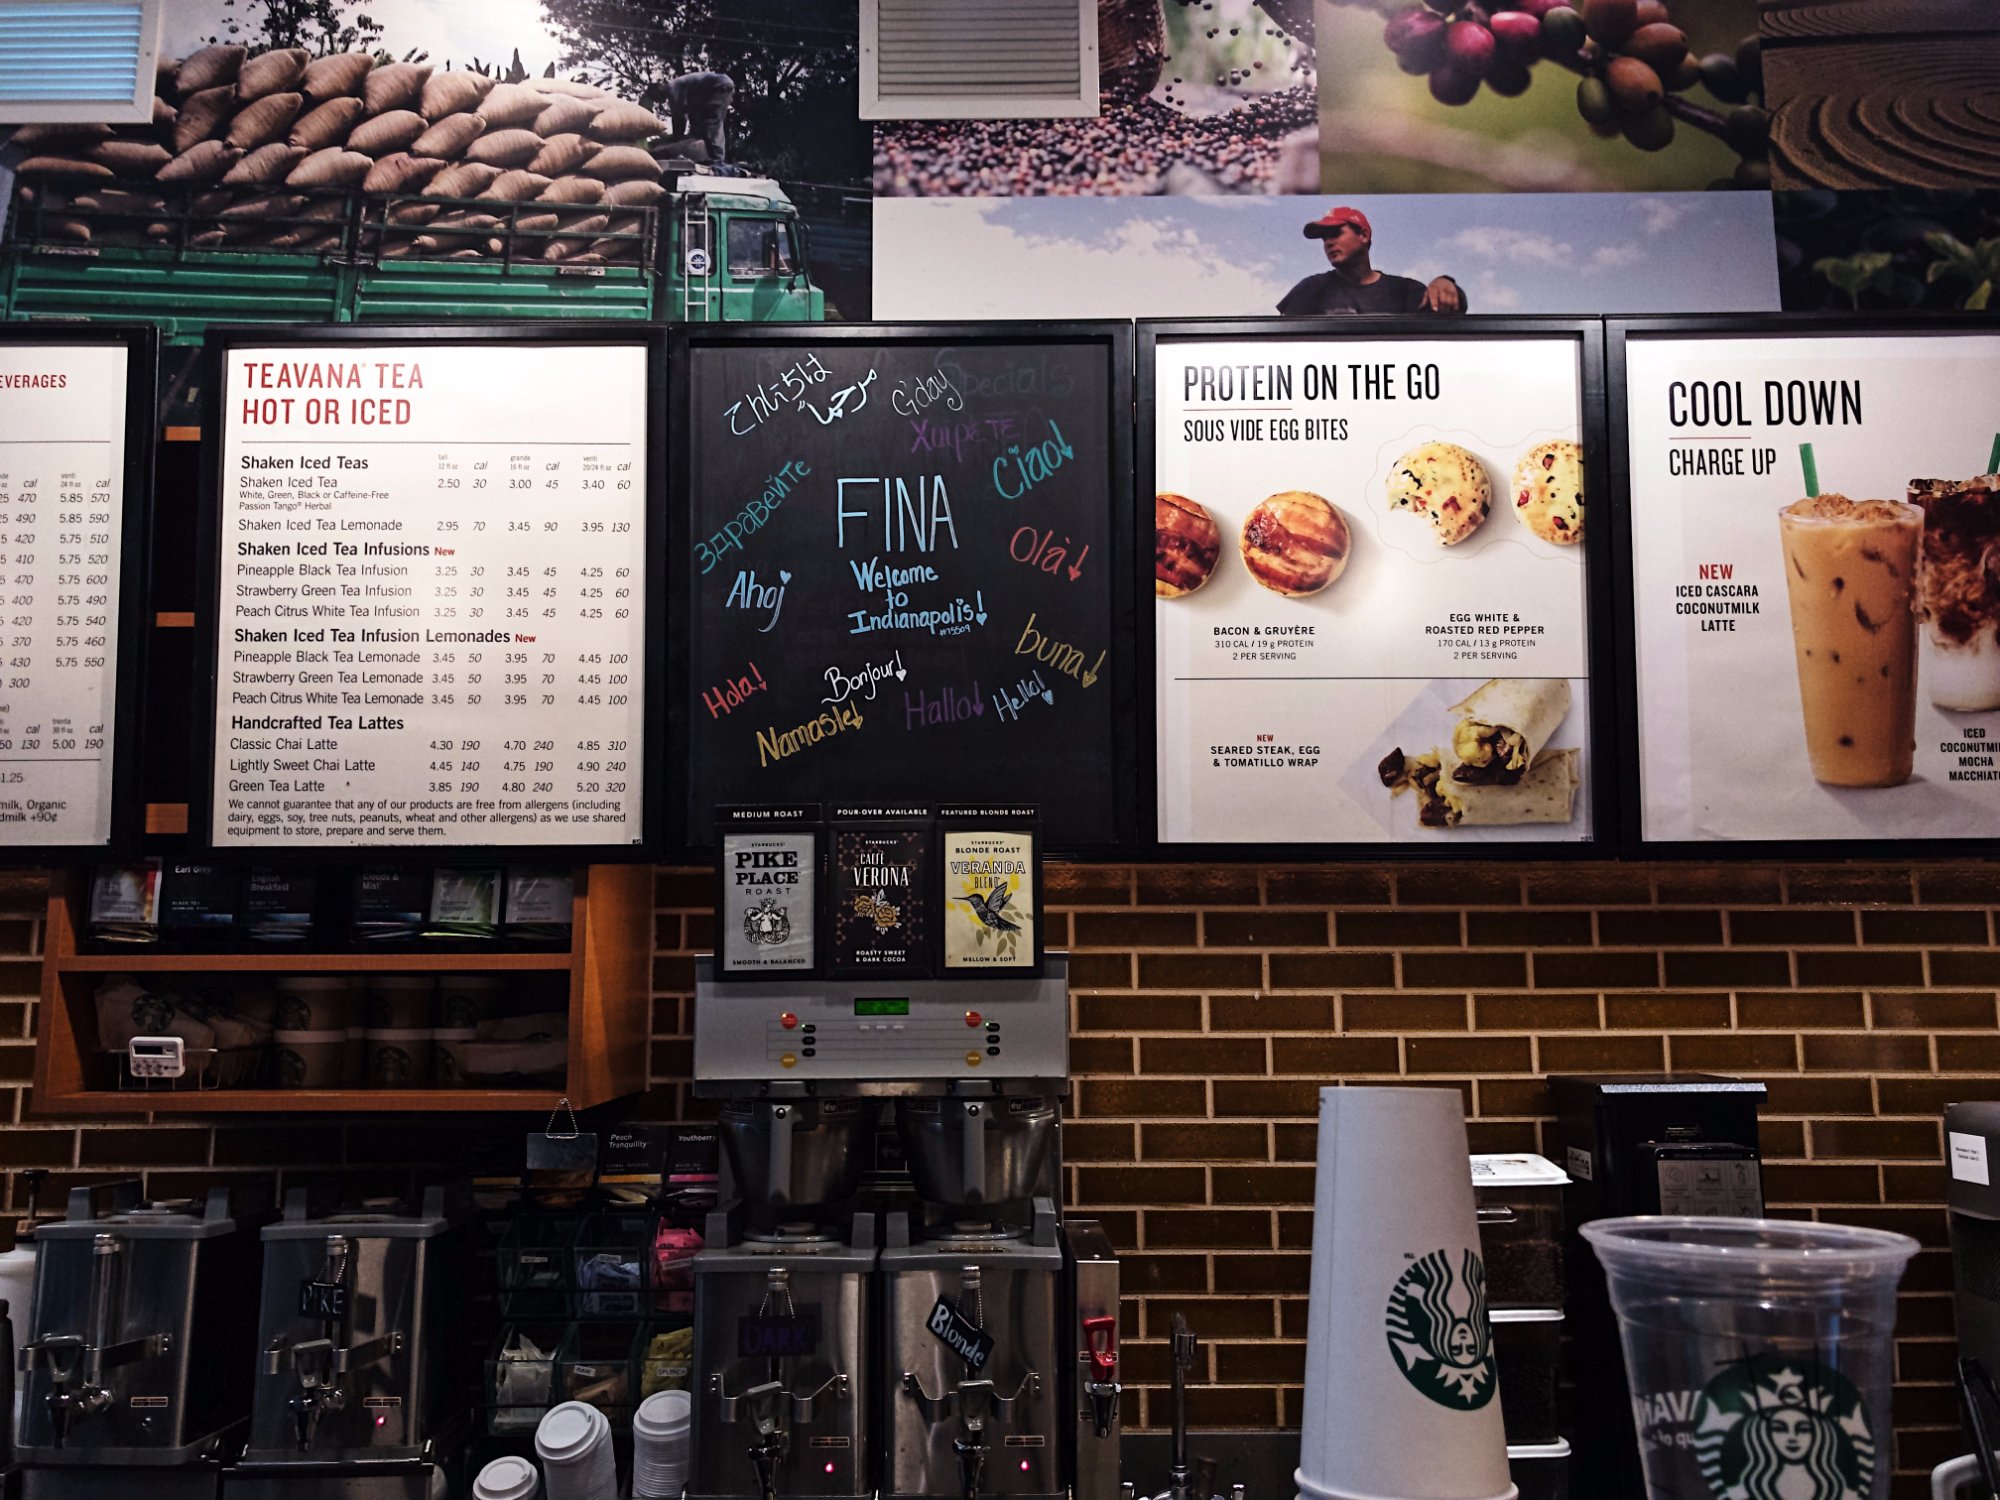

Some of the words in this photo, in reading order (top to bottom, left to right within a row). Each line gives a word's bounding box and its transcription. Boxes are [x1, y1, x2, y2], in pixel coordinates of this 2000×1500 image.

[375, 363, 423, 389] TEA
[1184, 364, 1292, 402] PROTEIN
[1303, 363, 1337, 401] ON
[1347, 363, 1397, 400] THE
[1406, 363, 1440, 401] GO
[1669, 380, 1752, 427] COOL
[1764, 380, 1862, 426] DOWN
[242, 398, 296, 425] HOT
[305, 398, 340, 425] OR
[351, 398, 411, 426] ICED
[1183, 419, 1225, 442] SOUS
[1230, 419, 1264, 442] VIDE
[1270, 418, 1299, 441] EGG
[1305, 418, 1348, 441] BITES
[241, 455, 294, 470] Shaken
[300, 455, 331, 469] Iced
[336, 455, 369, 470] Teas
[993, 420, 1073, 499] Ciao!
[1669, 448, 1745, 476] CHARGE
[1751, 448, 1777, 476] UP
[837, 475, 959, 552] FINA
[237, 541, 291, 556] Shaken
[296, 541, 328, 556] Iced
[332, 541, 358, 556] Tea
[364, 541, 430, 556] Infusions
[434, 546, 455, 556] New
[850, 557, 939, 592] Welcome
[1699, 564, 1733, 580] NEW
[1676, 585, 1703, 598] ICED
[1705, 584, 1759, 598] CASCARA
[725, 570, 792, 632] Ahoj
[885, 590, 909, 609] to
[235, 604, 271, 617] Peach
[274, 604, 309, 617] Citrus
[311, 605, 346, 617] White
[349, 604, 370, 617] Tea
[374, 604, 420, 617] Infusion
[848, 591, 988, 635] Indianapolis!
[1675, 602, 1760, 615] COCONUTMILK
[1449, 613, 1471, 623] EGG
[1474, 613, 1509, 623] WHITE
[1512, 613, 1520, 623] &
[1213, 626, 1250, 636] BACON
[1253, 626, 1261, 636] &
[1264, 624, 1315, 636] GRUYÈRE
[1425, 625, 1474, 635] ROASTED
[1477, 625, 1500, 635] RED
[1503, 625, 1545, 635] PEPPER
[1701, 619, 1736, 632] LATTE
[1214, 640, 1232, 649] 310
[1232, 640, 1249, 648] CAL
[1251, 640, 1255, 648] /
[1257, 640, 1268, 648] 19
[1269, 641, 1276, 650] g
[1277, 639, 1314, 648] PROTEIN
[1438, 639, 1454, 648] 170
[1455, 639, 1472, 648] CAL
[1473, 639, 1477, 647] /
[1479, 639, 1490, 648] 13
[1491, 641, 1498, 649] g
[1499, 639, 1536, 648] PROTEIN
[1232, 652, 1238, 661] 2
[1240, 652, 1257, 661] PER
[1259, 652, 1297, 661] SERVING
[1453, 651, 1459, 660] 2
[1461, 651, 1478, 660] PER
[1480, 651, 1518, 660] SERVING
[821, 650, 907, 704] Bonjour!
[702, 662, 768, 720] Hola!
[992, 670, 1054, 723] Hello!
[904, 681, 985, 730] Hallo!
[231, 715, 322, 730] Handcrafted
[327, 715, 353, 730] Tea
[358, 715, 405, 730] Lattes
[1256, 734, 1274, 743] NEW
[1963, 727, 1986, 739] ICED
[230, 737, 272, 750] Classic
[275, 737, 302, 750] Chai
[307, 738, 338, 750] Latte
[429, 740, 454, 751] 4.30
[461, 740, 481, 751] 190
[503, 740, 527, 751] 4.70
[533, 740, 554, 751] 240
[576, 740, 601, 751] 4.85
[607, 740, 627, 751] 310
[1210, 745, 1253, 755] SEARED
[1256, 745, 1295, 756] STEAK,
[1298, 745, 1321, 755] EGG
[1212, 758, 1221, 767] &
[1224, 758, 1284, 768] TOMATILLO
[1287, 758, 1319, 767] WRAP
[1958, 756, 1994, 767] MOCHA
[1948, 770, 2000, 782] MACCHIAT
[732, 811, 771, 819] MEDIUM
[774, 810, 803, 818] ROAST
[837, 808, 883, 816] POUR-OVER
[955, 846, 989, 854] BLONDE
[993, 846, 1021, 854] ROAST
[735, 850, 798, 869] PIKE
[174, 865, 191, 874] Earl
[949, 860, 1027, 875] VERANDA
[735, 871, 801, 886] PLACE
[853, 866, 909, 887] VERONA
[250, 882, 290, 892] Breakfast
[745, 887, 791, 896] ROAST
[610, 1133, 633, 1141] Peach
[678, 1134, 717, 1143] Youthberry
[608, 1141, 648, 1149] Tranquility
[302, 1285, 344, 1314] PIKE
[743, 1324, 808, 1354] DARK
[931, 1303, 985, 1367] Blonde
